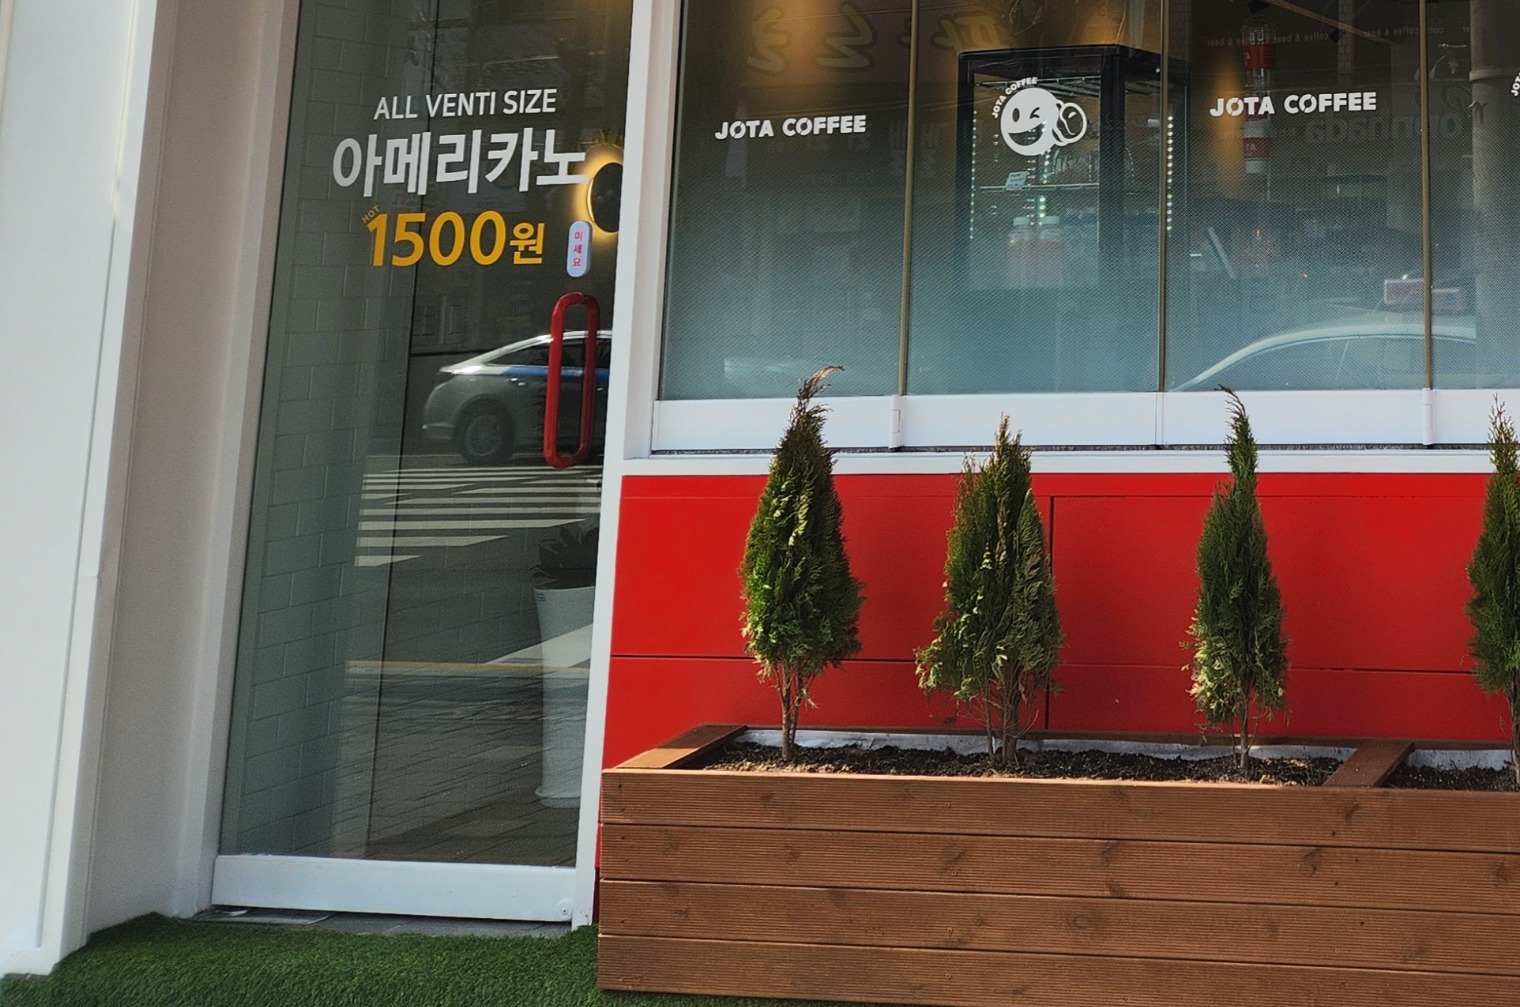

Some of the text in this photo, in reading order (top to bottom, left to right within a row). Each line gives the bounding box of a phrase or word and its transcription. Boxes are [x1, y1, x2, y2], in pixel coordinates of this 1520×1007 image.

[373, 88, 558, 120] ALL VENTI SIZE
[991, 76, 1038, 119] JOTA COFFEE
[1209, 92, 1377, 117] JOTA COFFEE
[714, 115, 867, 140] JOTA COFFEE
[333, 128, 590, 198] 아메리카노
[361, 204, 380, 225] HOT
[367, 210, 546, 269] 1500원
[571, 230, 585, 268] 미세요
